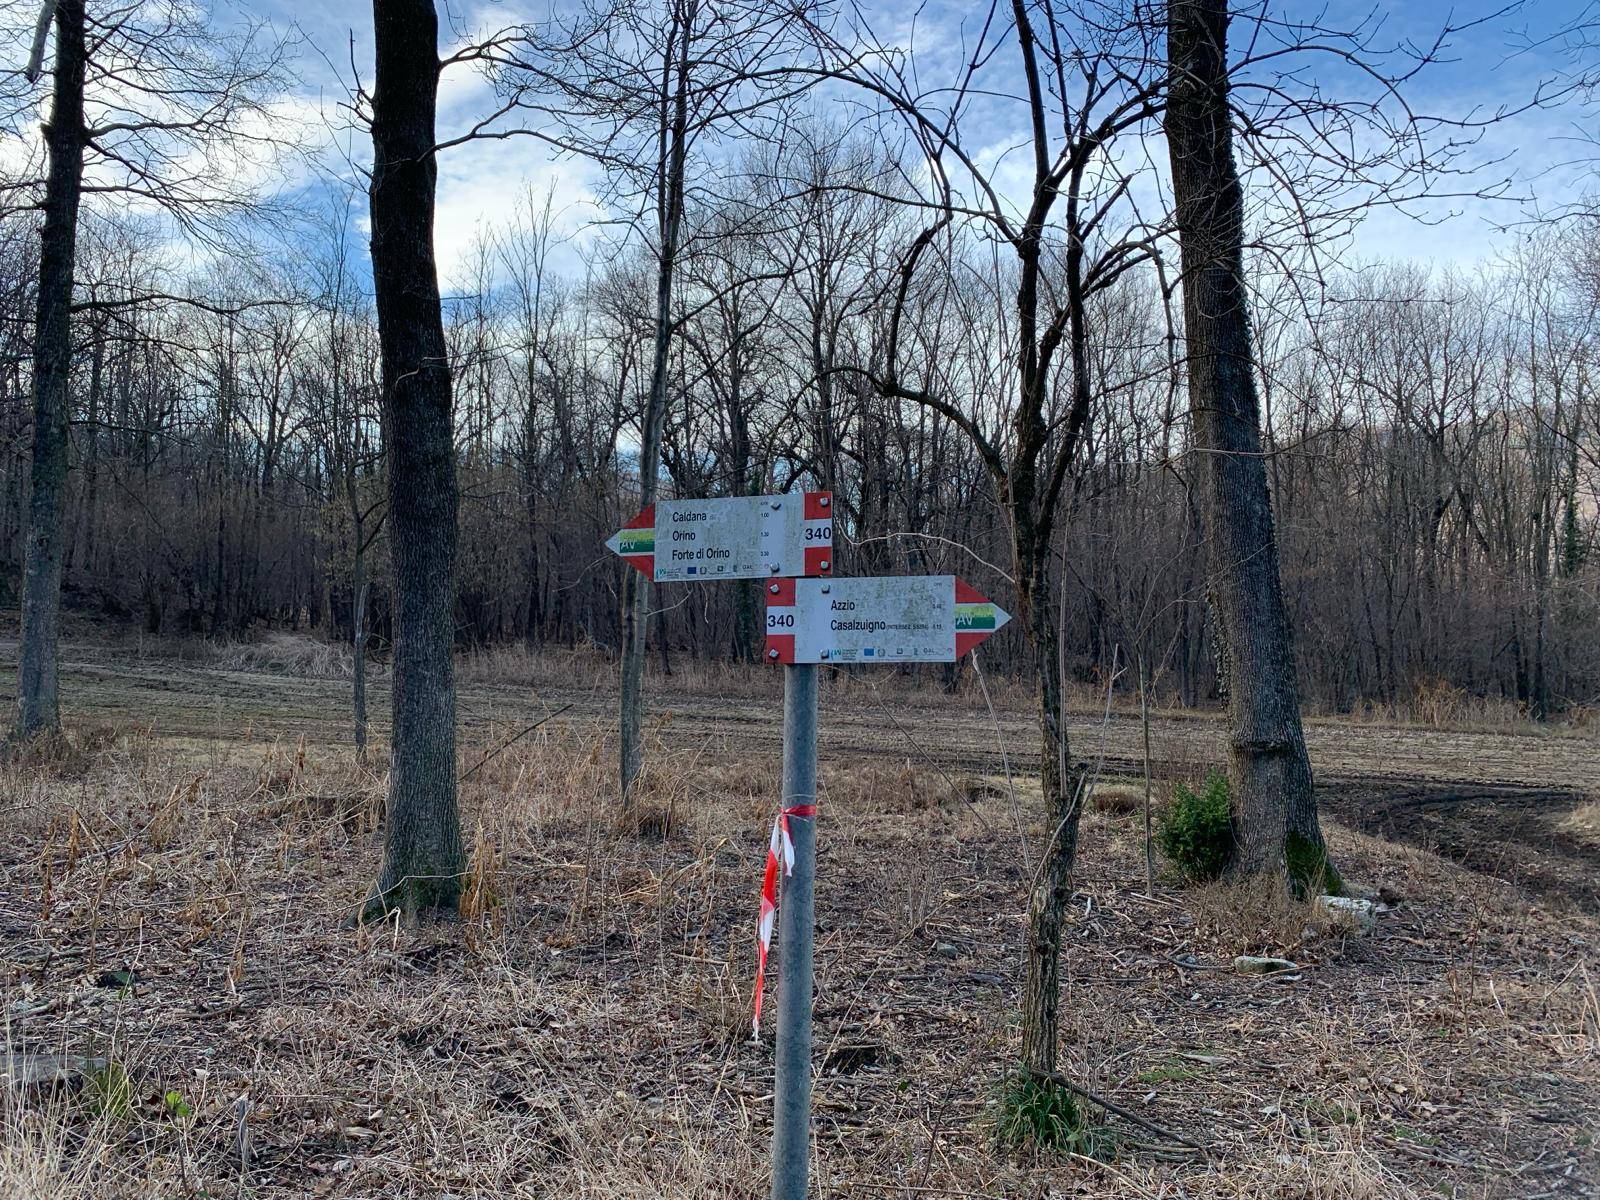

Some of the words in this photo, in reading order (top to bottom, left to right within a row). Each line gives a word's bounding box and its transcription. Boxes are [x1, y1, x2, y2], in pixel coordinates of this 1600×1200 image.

[672, 511, 707, 523] Caldana
[672, 530, 696, 542] Orino
[805, 526, 832, 541] 340
[620, 538, 636, 550] AV
[672, 549, 695, 561] Forte
[696, 548, 704, 560] di
[706, 547, 730, 559] Orino
[831, 599, 856, 611] Azzio
[767, 614, 795, 628] 340
[830, 619, 886, 633] Casalzuigno
[956, 612, 974, 626] AV
